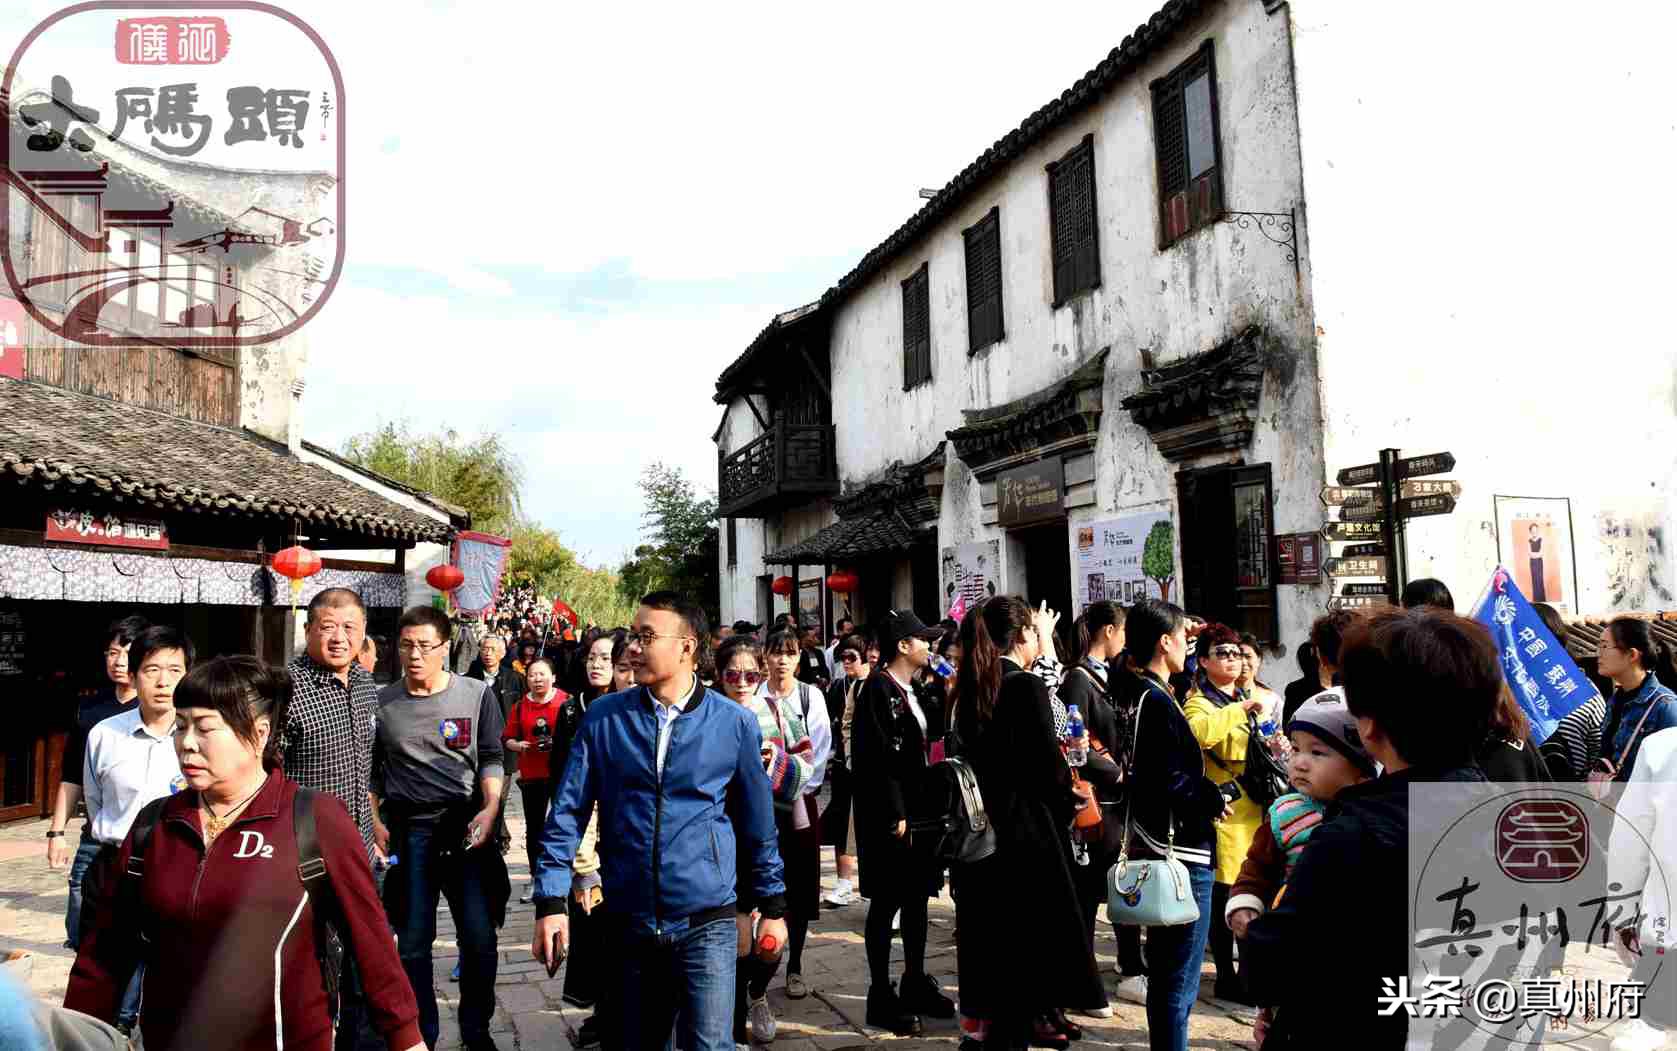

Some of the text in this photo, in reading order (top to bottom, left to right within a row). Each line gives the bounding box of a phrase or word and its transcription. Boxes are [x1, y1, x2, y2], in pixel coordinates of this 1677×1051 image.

[1348, 559, 1378, 570] 卫生间
[233, 830, 274, 858] D2
